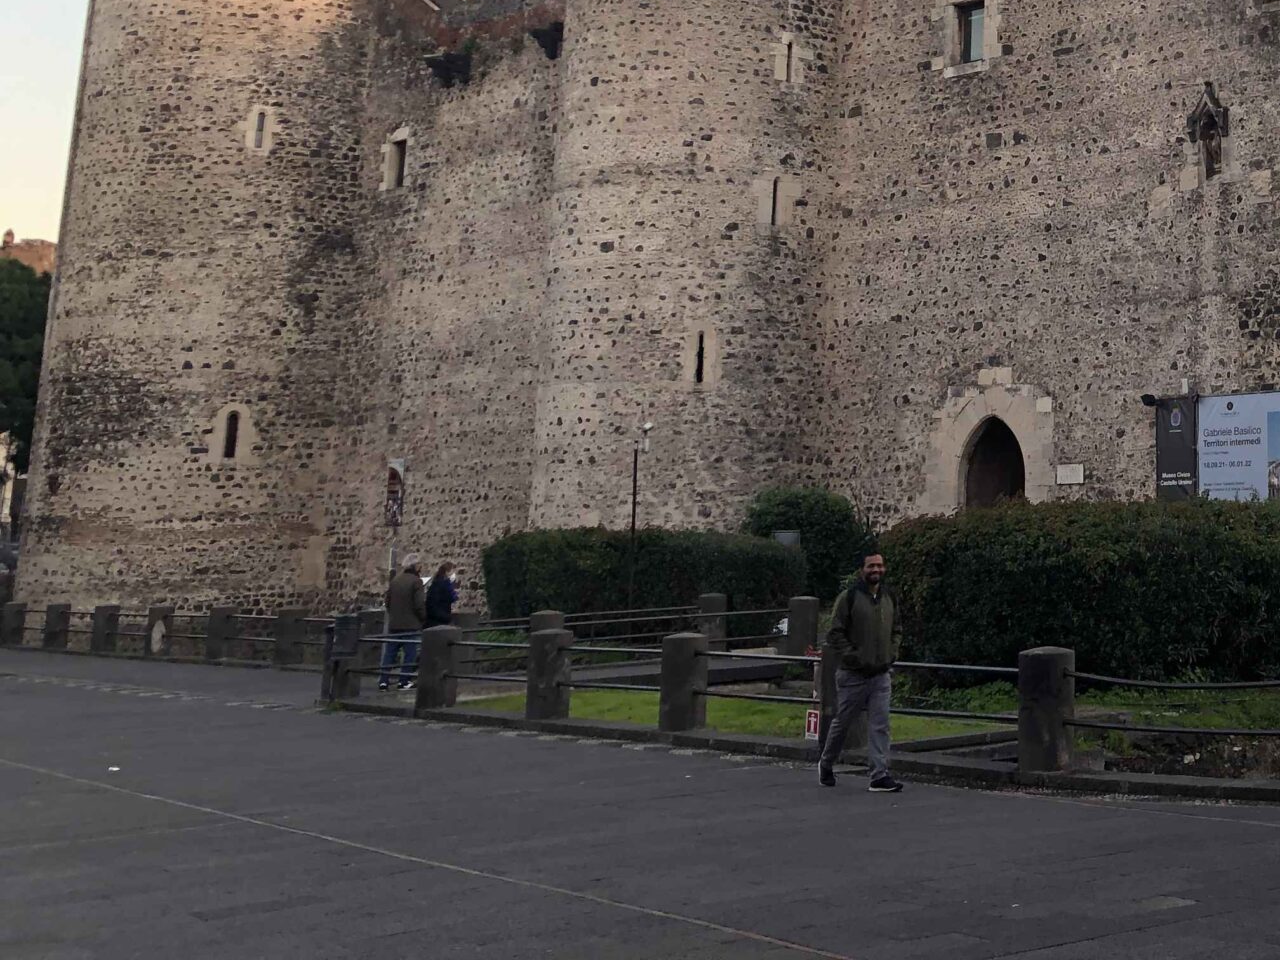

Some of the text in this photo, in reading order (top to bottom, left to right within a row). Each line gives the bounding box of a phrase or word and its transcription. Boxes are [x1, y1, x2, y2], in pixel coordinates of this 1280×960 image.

[1203, 426, 1261, 437] Gabriele Basilico
[1203, 437, 1261, 447] Territori intermedi
